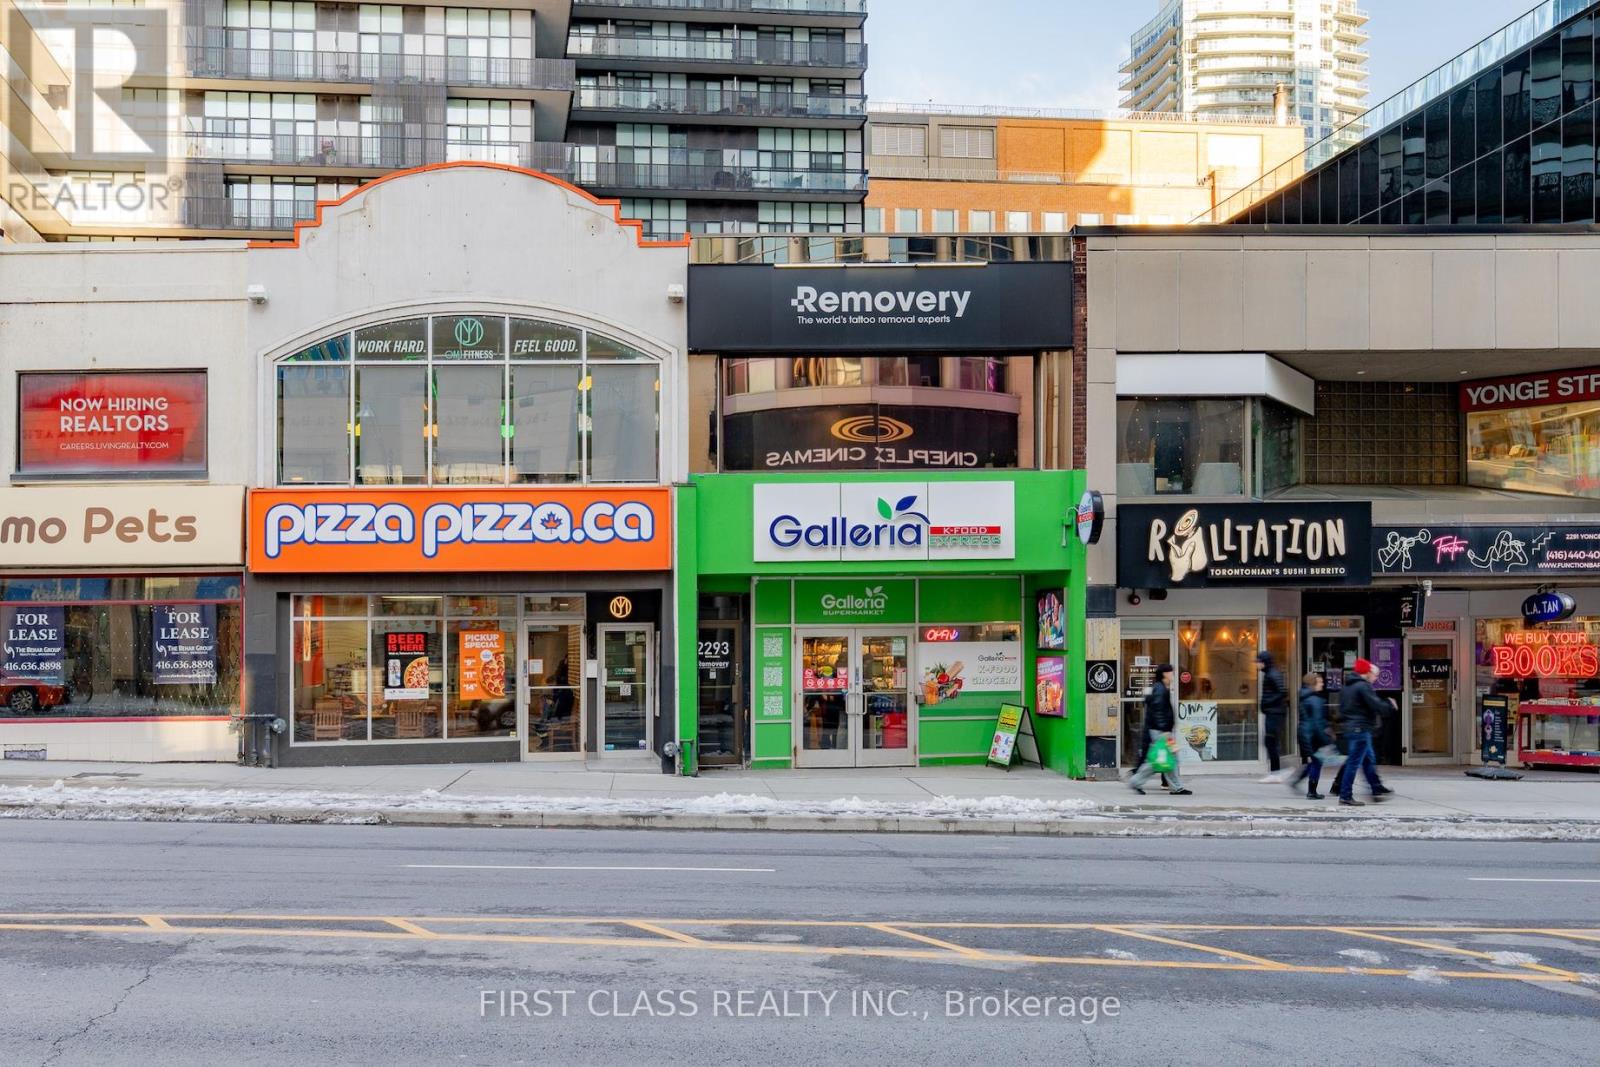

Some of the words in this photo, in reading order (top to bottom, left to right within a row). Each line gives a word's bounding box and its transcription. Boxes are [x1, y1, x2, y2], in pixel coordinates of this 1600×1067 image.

[791, 286, 972, 318] Removery
[797, 315, 814, 325] The
[816, 315, 847, 325] world's
[849, 315, 876, 325] tattoo
[878, 315, 916, 324] removal
[917, 316, 951, 325] experts
[357, 340, 390, 353] WORK
[393, 340, 427, 353] HARD.
[514, 340, 541, 352] FEEL
[544, 340, 578, 352] GOOD.
[1466, 379, 1550, 406] YONGE
[60, 398, 103, 412] NOW
[107, 397, 168, 411] HIRING
[60, 415, 169, 432] REALTORS
[83, 507, 197, 544] Pets
[264, 502, 415, 558] pizza
[421, 501, 655, 558] pizza.ca
[769, 511, 930, 548] Galleria
[942, 527, 988, 535] K-FOOD
[1546, 550, 1568, 561] (416)
[1210, 568, 1280, 577] TORONTONIAN'S
[1283, 567, 1307, 576] SUSHI
[1310, 567, 1346, 575] BURRITO
[821, 593, 888, 609] Galleria
[1525, 602, 1541, 615] L.A.
[1542, 600, 1559, 614] TAN
[16, 613, 49, 626] FOR
[168, 612, 201, 624] FOR
[9, 629, 58, 641] LEASE
[160, 627, 210, 640] LEASE
[388, 634, 425, 644] BEER
[464, 633, 499, 641] PICKUP
[1504, 632, 1524, 645] WE
[1525, 632, 1550, 644] BUY
[1552, 631, 1588, 644] YOUR
[464, 641, 500, 649] SPECIAL
[698, 641, 730, 655] 2293
[3, 662, 61, 671] 416.636.8898
[155, 660, 214, 669] 416.636.8898
[1493, 644, 1598, 677] BOOKS
[1413, 665, 1430, 673] L.A.
[1431, 664, 1448, 673] TAN
